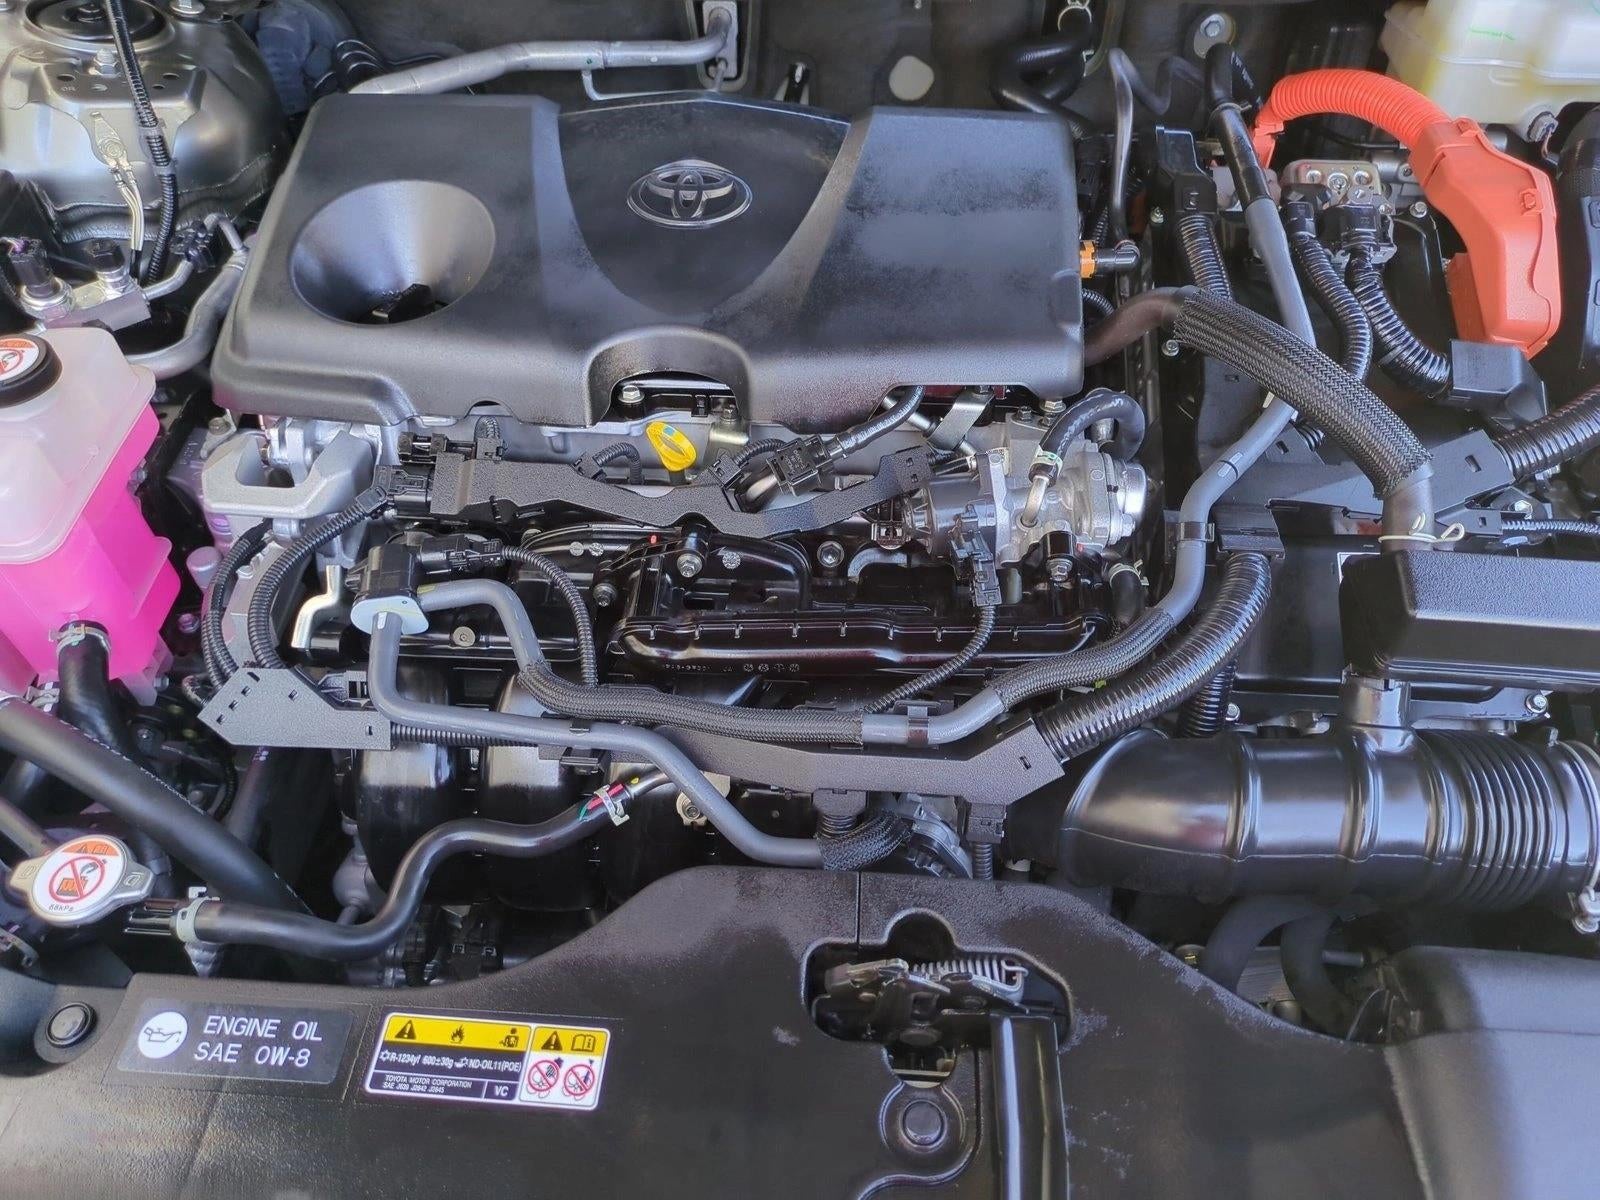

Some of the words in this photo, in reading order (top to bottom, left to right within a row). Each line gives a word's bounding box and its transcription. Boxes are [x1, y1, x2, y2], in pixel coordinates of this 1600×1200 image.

[203, 1015, 281, 1038] ENGINE
[291, 1021, 322, 1041] OIL
[194, 1042, 242, 1063] SAE
[255, 1045, 311, 1068] 0W-8
[383, 1081, 396, 1090] SAE
[385, 1074, 408, 1084] TOYOTA
[409, 1077, 431, 1085] MOTOR
[431, 1078, 473, 1089] CORPORATION
[494, 1085, 509, 1097] VC
